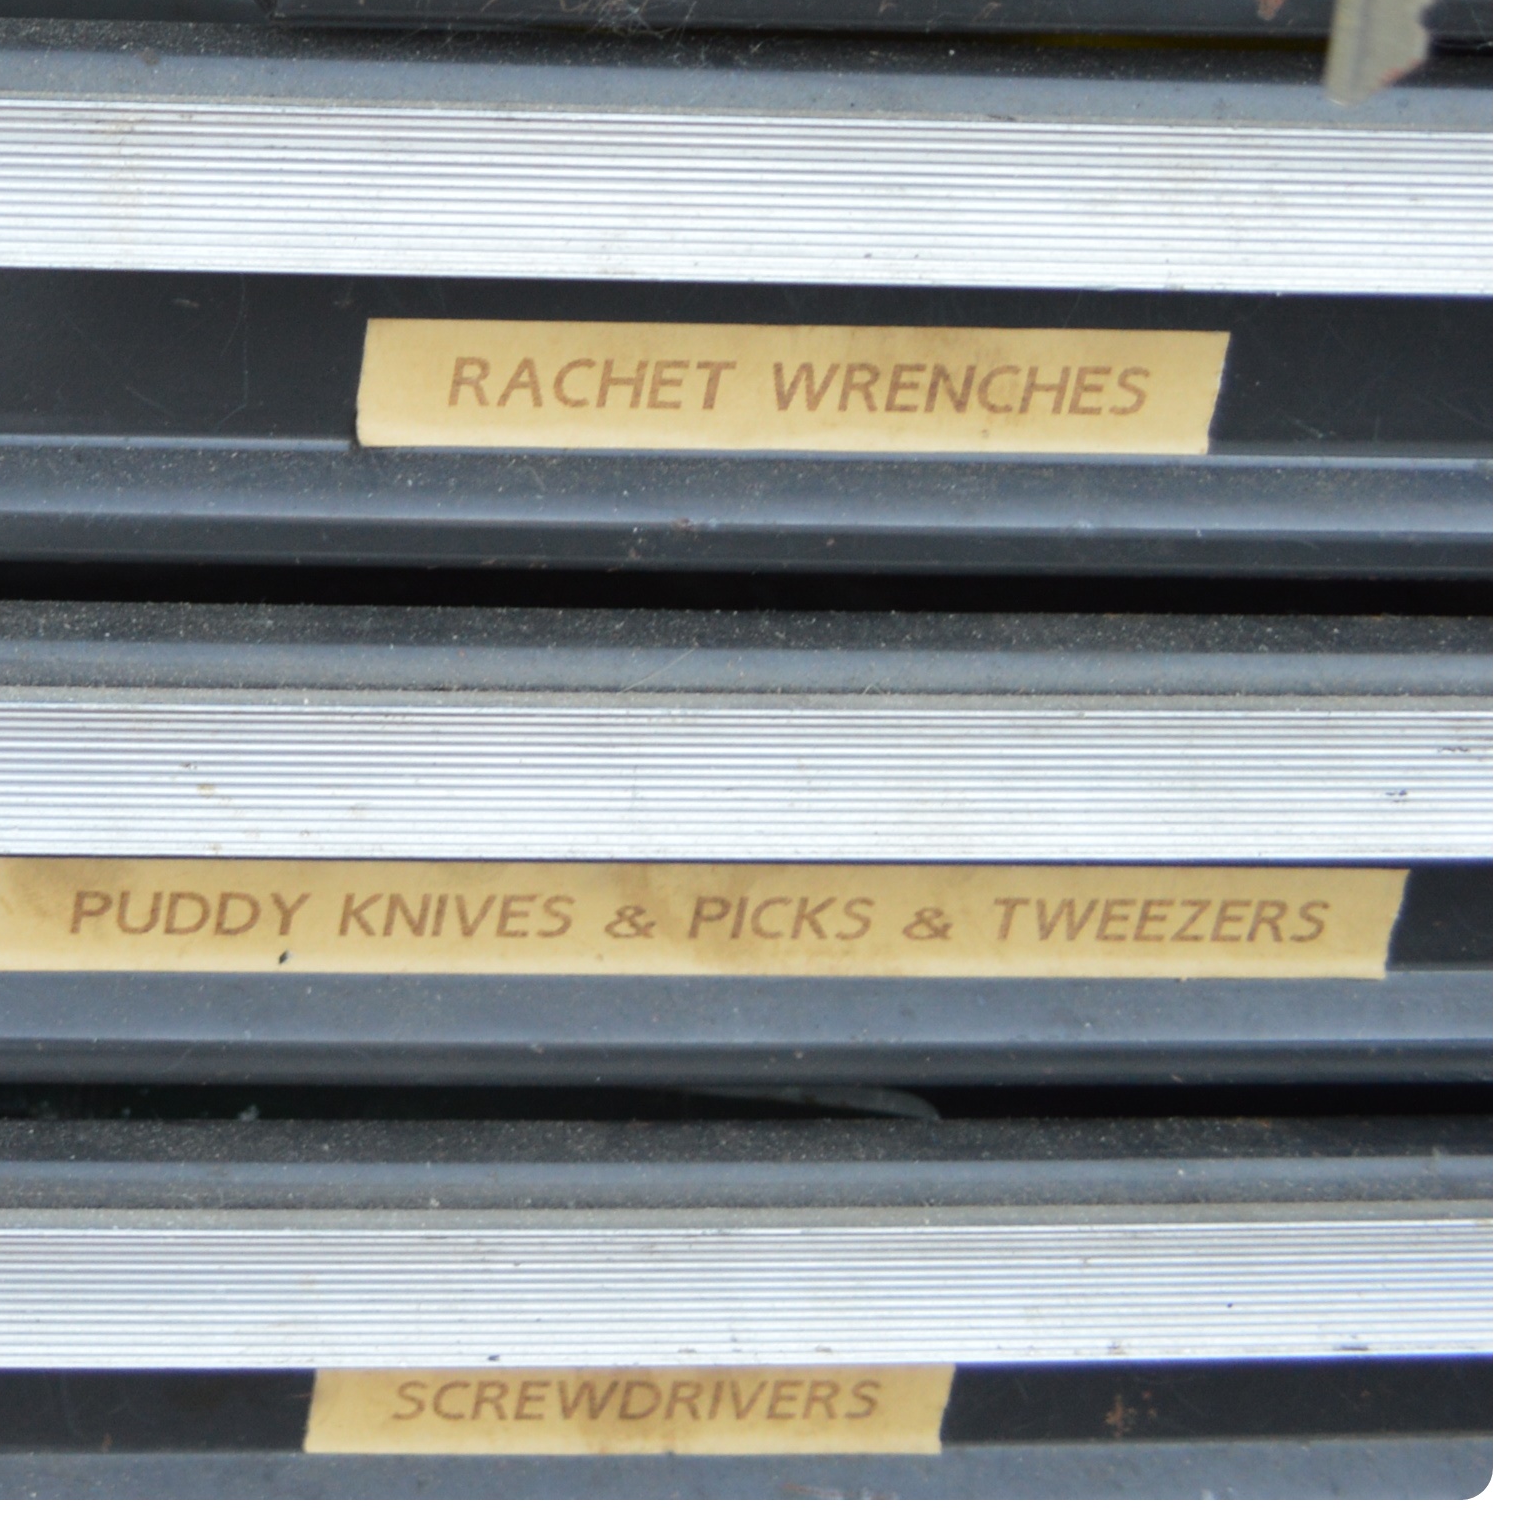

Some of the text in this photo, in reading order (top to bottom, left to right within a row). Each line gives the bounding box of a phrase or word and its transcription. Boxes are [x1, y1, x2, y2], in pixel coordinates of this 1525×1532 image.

[447, 356, 1152, 417] RACHET WRENCHES
[68, 889, 1331, 945] PUDDY KNIVES & PICKS & TWEEZERS
[392, 1378, 882, 1422] SCREWDRIVERS
